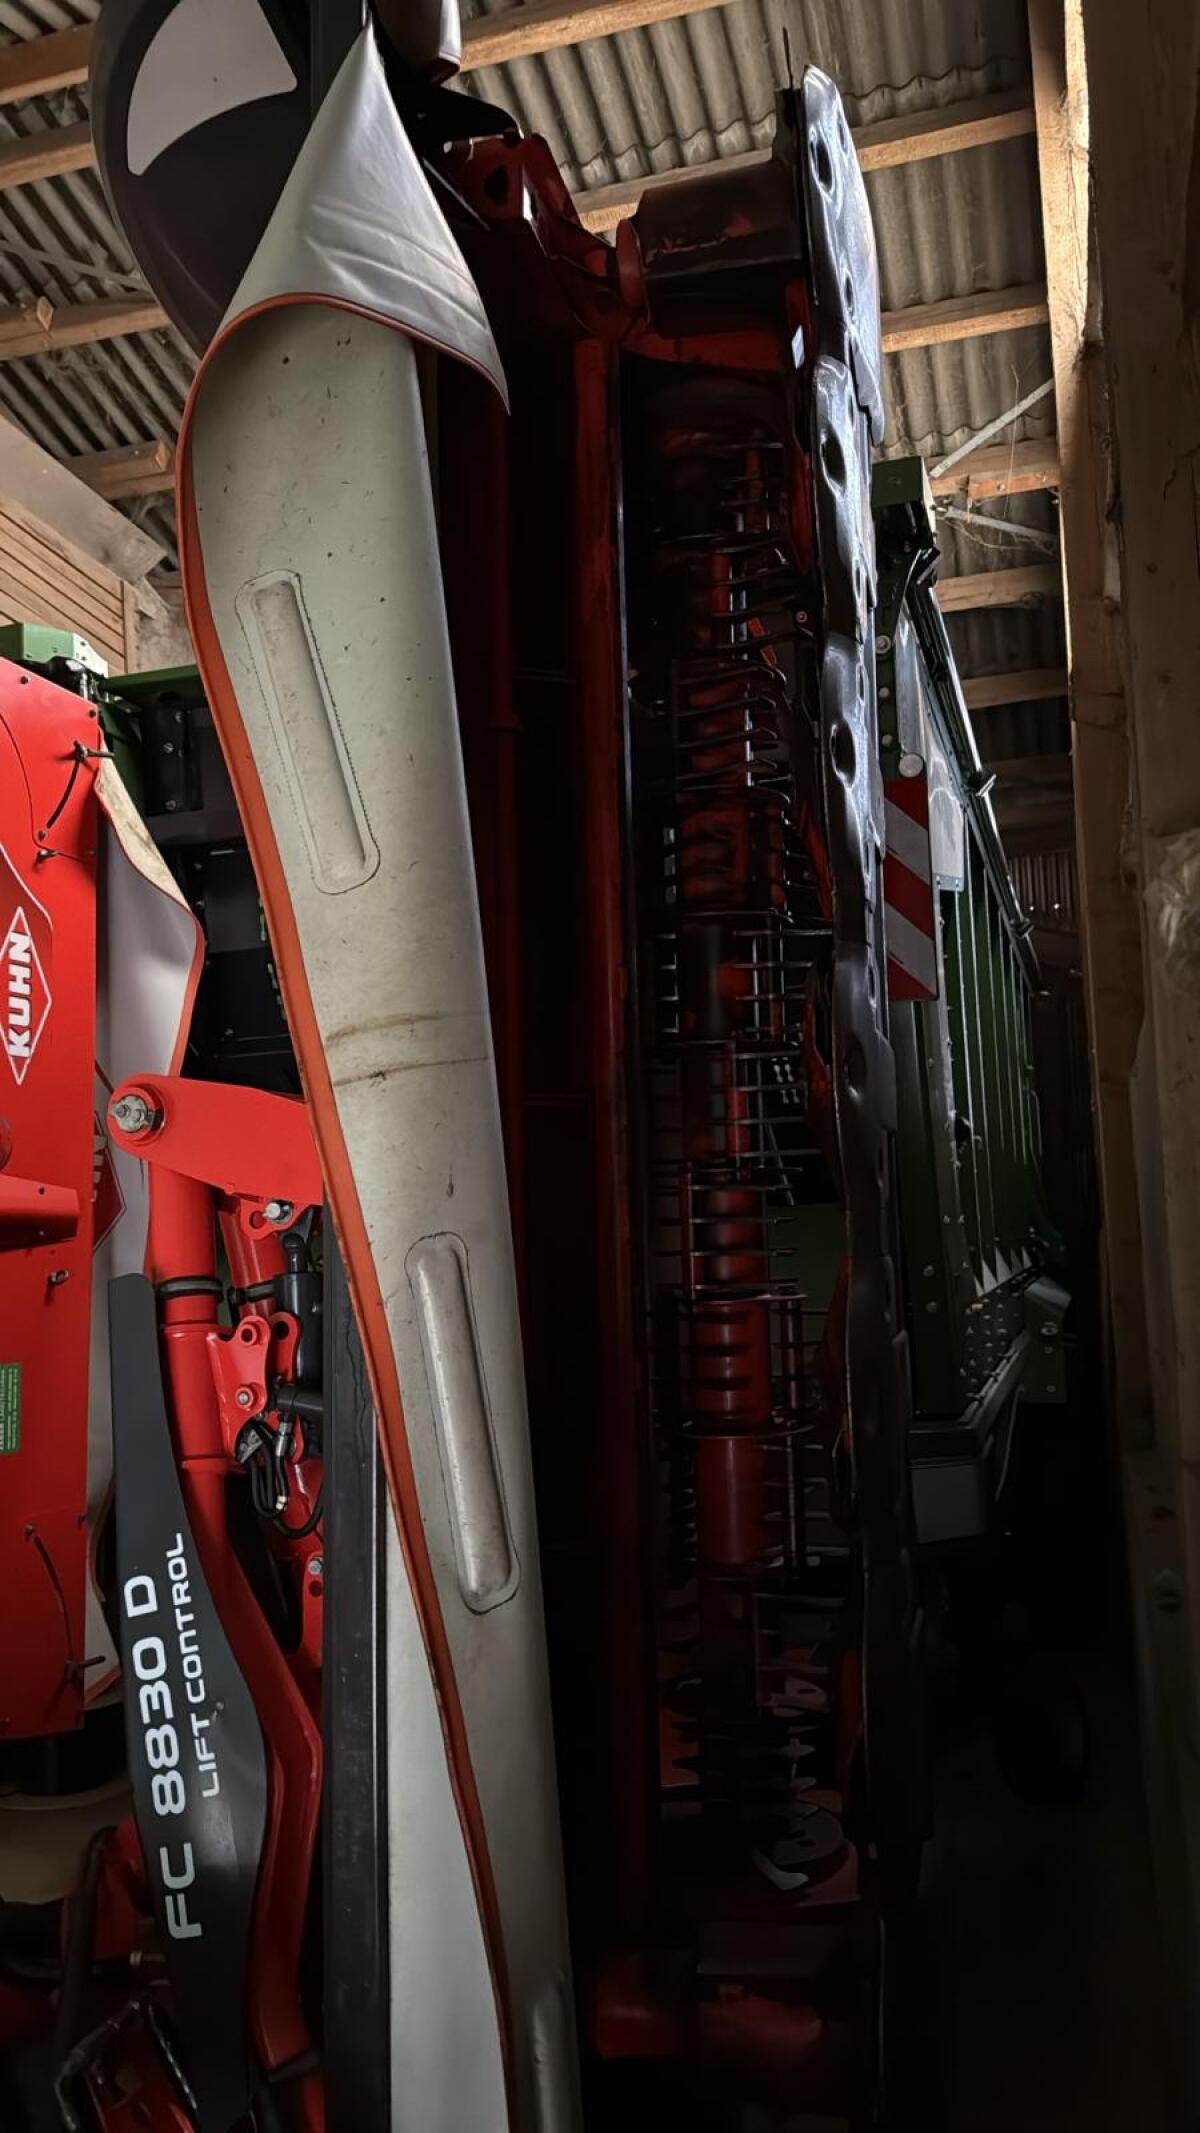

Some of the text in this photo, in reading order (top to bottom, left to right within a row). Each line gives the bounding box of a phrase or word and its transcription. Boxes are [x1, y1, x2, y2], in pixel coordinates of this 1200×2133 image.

[8, 931, 32, 1058] KUHN
[123, 1575, 203, 1940] FC 8830 D
[166, 1533, 218, 1798] LIFT CONTROL
